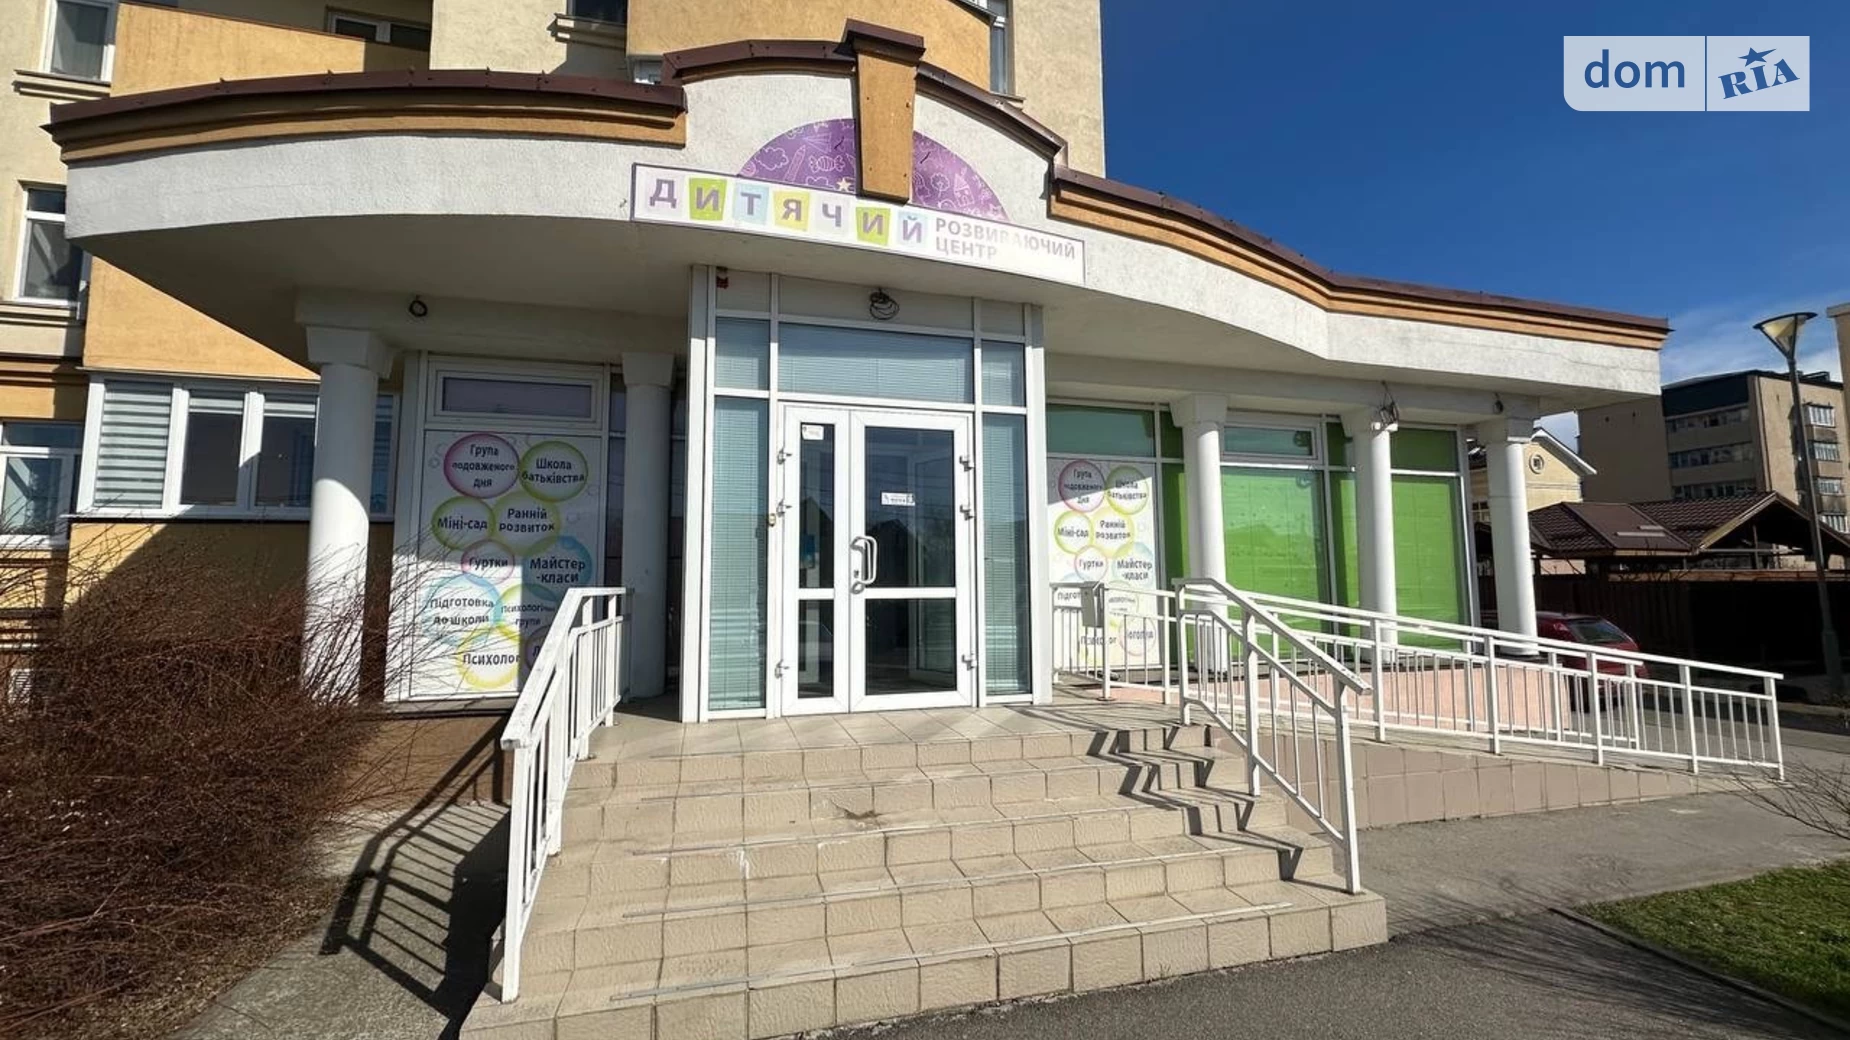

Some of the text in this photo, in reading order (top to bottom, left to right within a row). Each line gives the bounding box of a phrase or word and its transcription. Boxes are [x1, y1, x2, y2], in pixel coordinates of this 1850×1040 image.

[649, 177, 922, 244] ДИТЯЧИЙ
[935, 236, 998, 260] ЦЕНТР
[469, 444, 499, 457] Група
[535, 457, 572, 471] Школа
[473, 478, 493, 489] дня
[521, 470, 585, 485] батьківства
[507, 508, 548, 520] Ранній
[437, 515, 488, 531] Міні-сад
[498, 522, 556, 534] розвиток
[468, 556, 509, 571] Гуртки
[529, 557, 587, 571] Майстер
[1116, 558, 1153, 570] Майстер
[535, 572, 580, 585] -класи
[430, 597, 495, 609] Підготовка
[450, 615, 490, 626] школи
